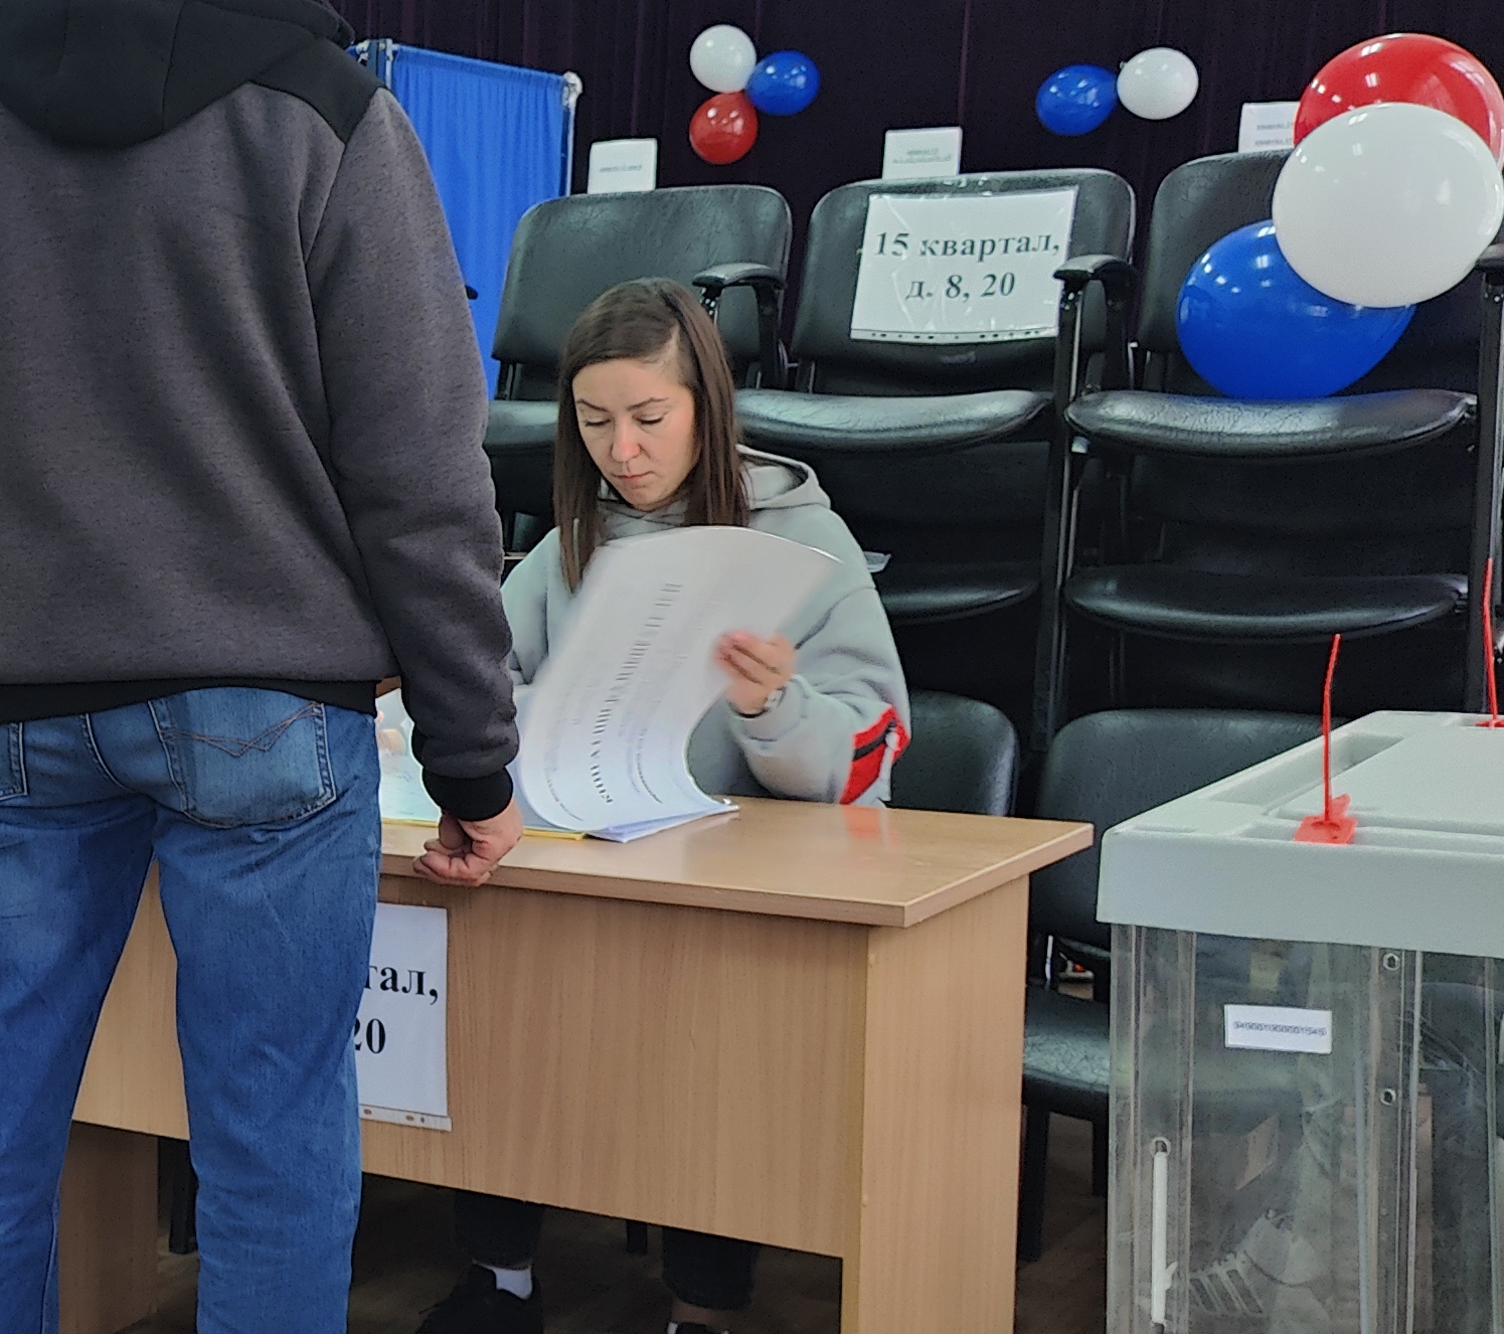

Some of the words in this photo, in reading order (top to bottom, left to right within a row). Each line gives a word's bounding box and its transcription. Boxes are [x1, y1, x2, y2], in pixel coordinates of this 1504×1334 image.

[874, 232, 910, 256] 15
[919, 233, 1061, 263] квартал,
[904, 280, 933, 301] д.
[945, 274, 971, 304] 8,
[980, 271, 1016, 298] 20
